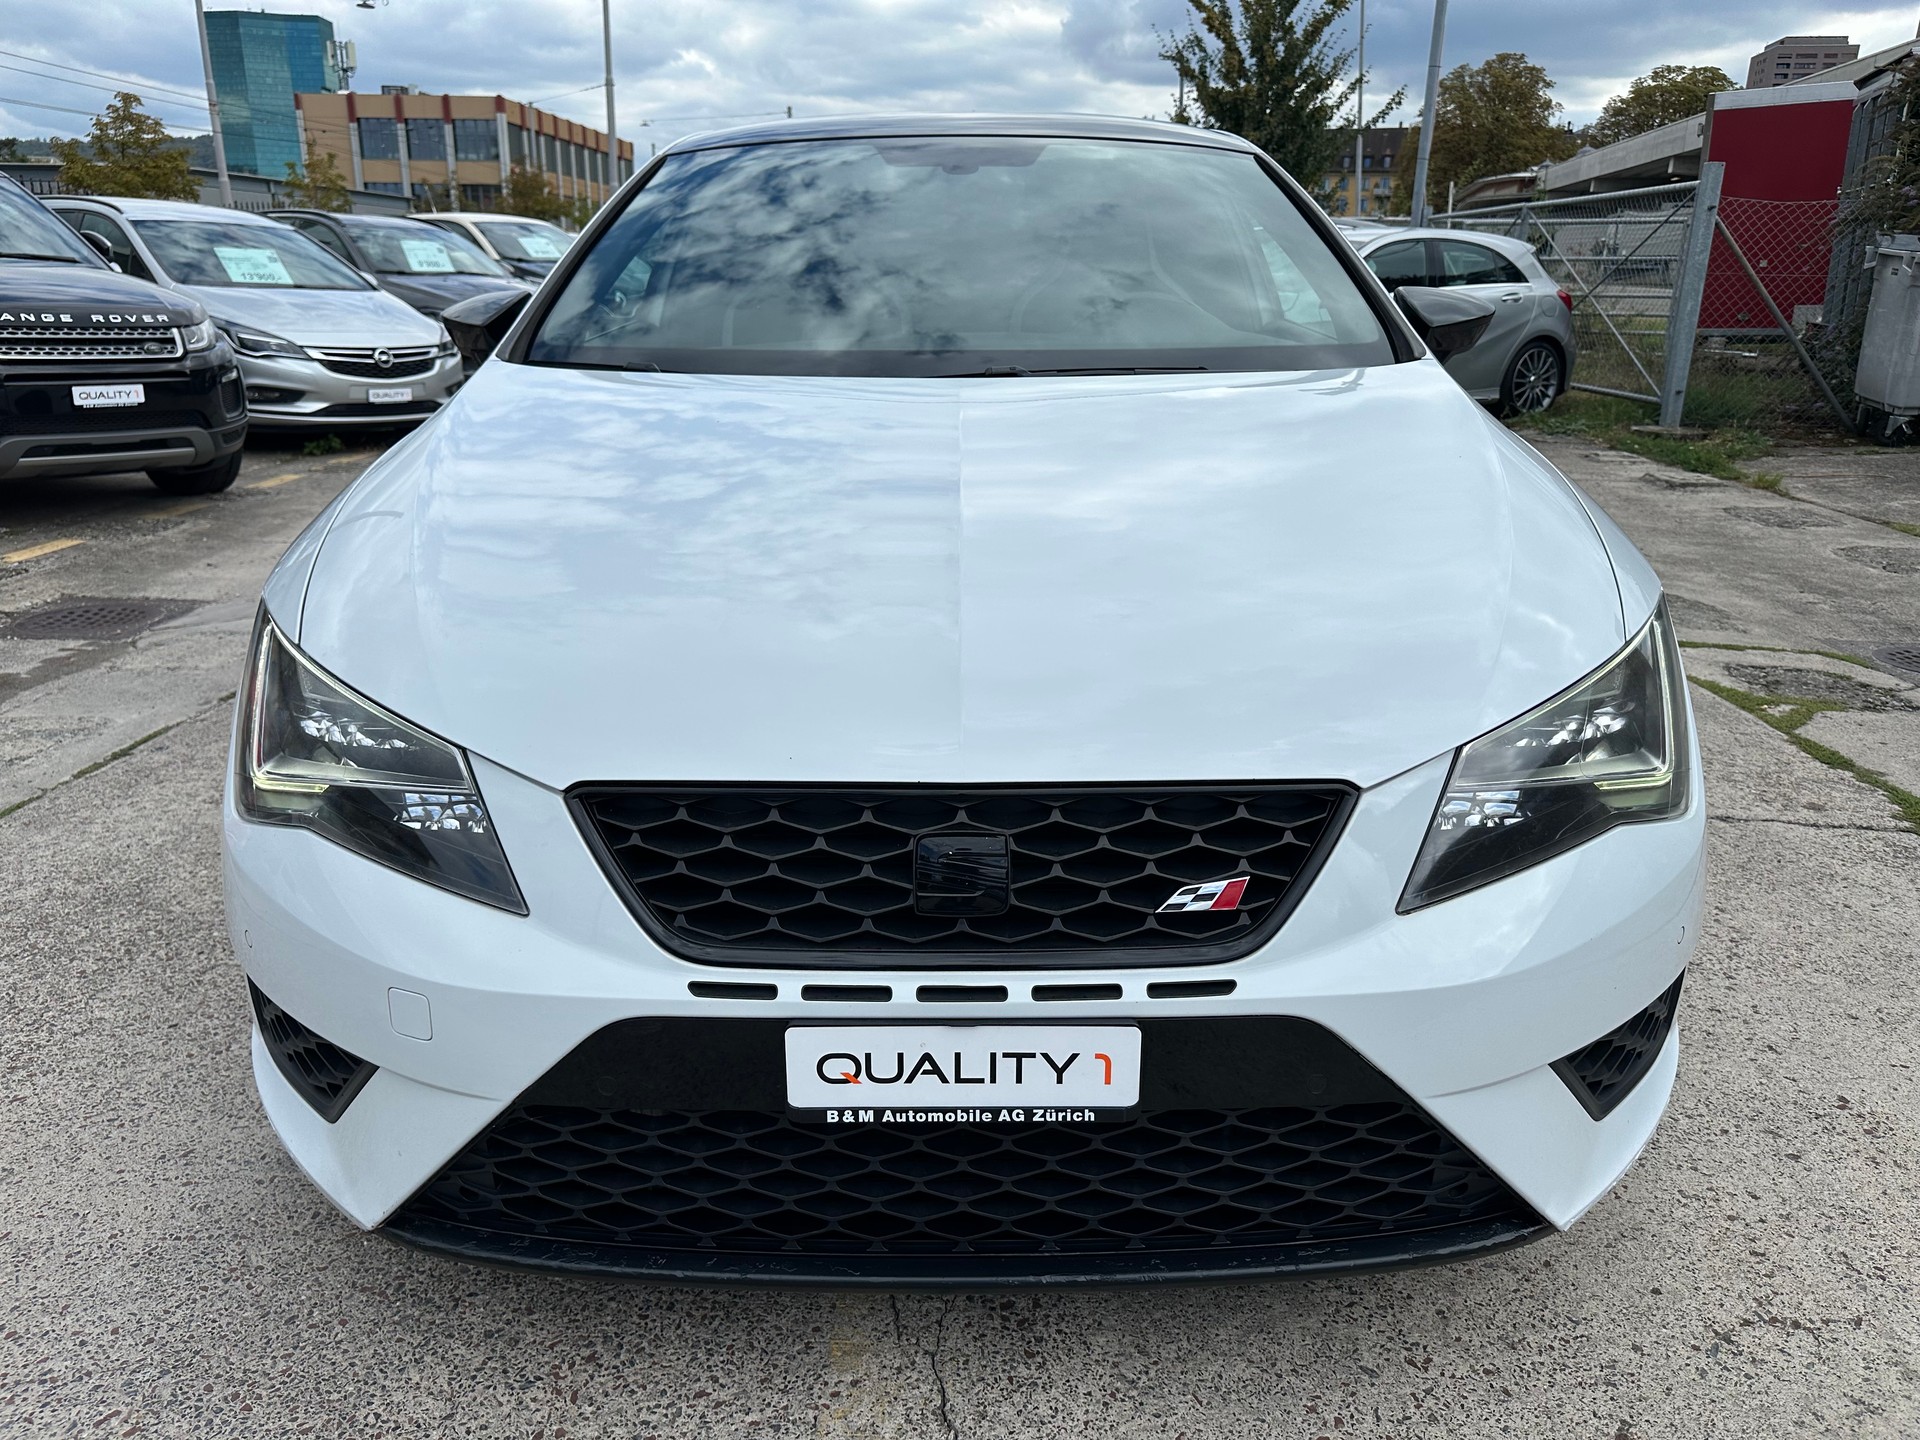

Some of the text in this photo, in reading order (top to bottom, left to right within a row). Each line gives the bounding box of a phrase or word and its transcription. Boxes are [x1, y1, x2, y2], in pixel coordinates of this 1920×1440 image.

[0, 312, 169, 323] ANGE ROVER
[79, 389, 139, 401] QUALITY 1
[816, 1051, 1112, 1086] QUALITY 1
[881, 1109, 993, 1123] Automobile
[998, 1109, 1025, 1122] AG
[1032, 1109, 1096, 1122] Zürich
